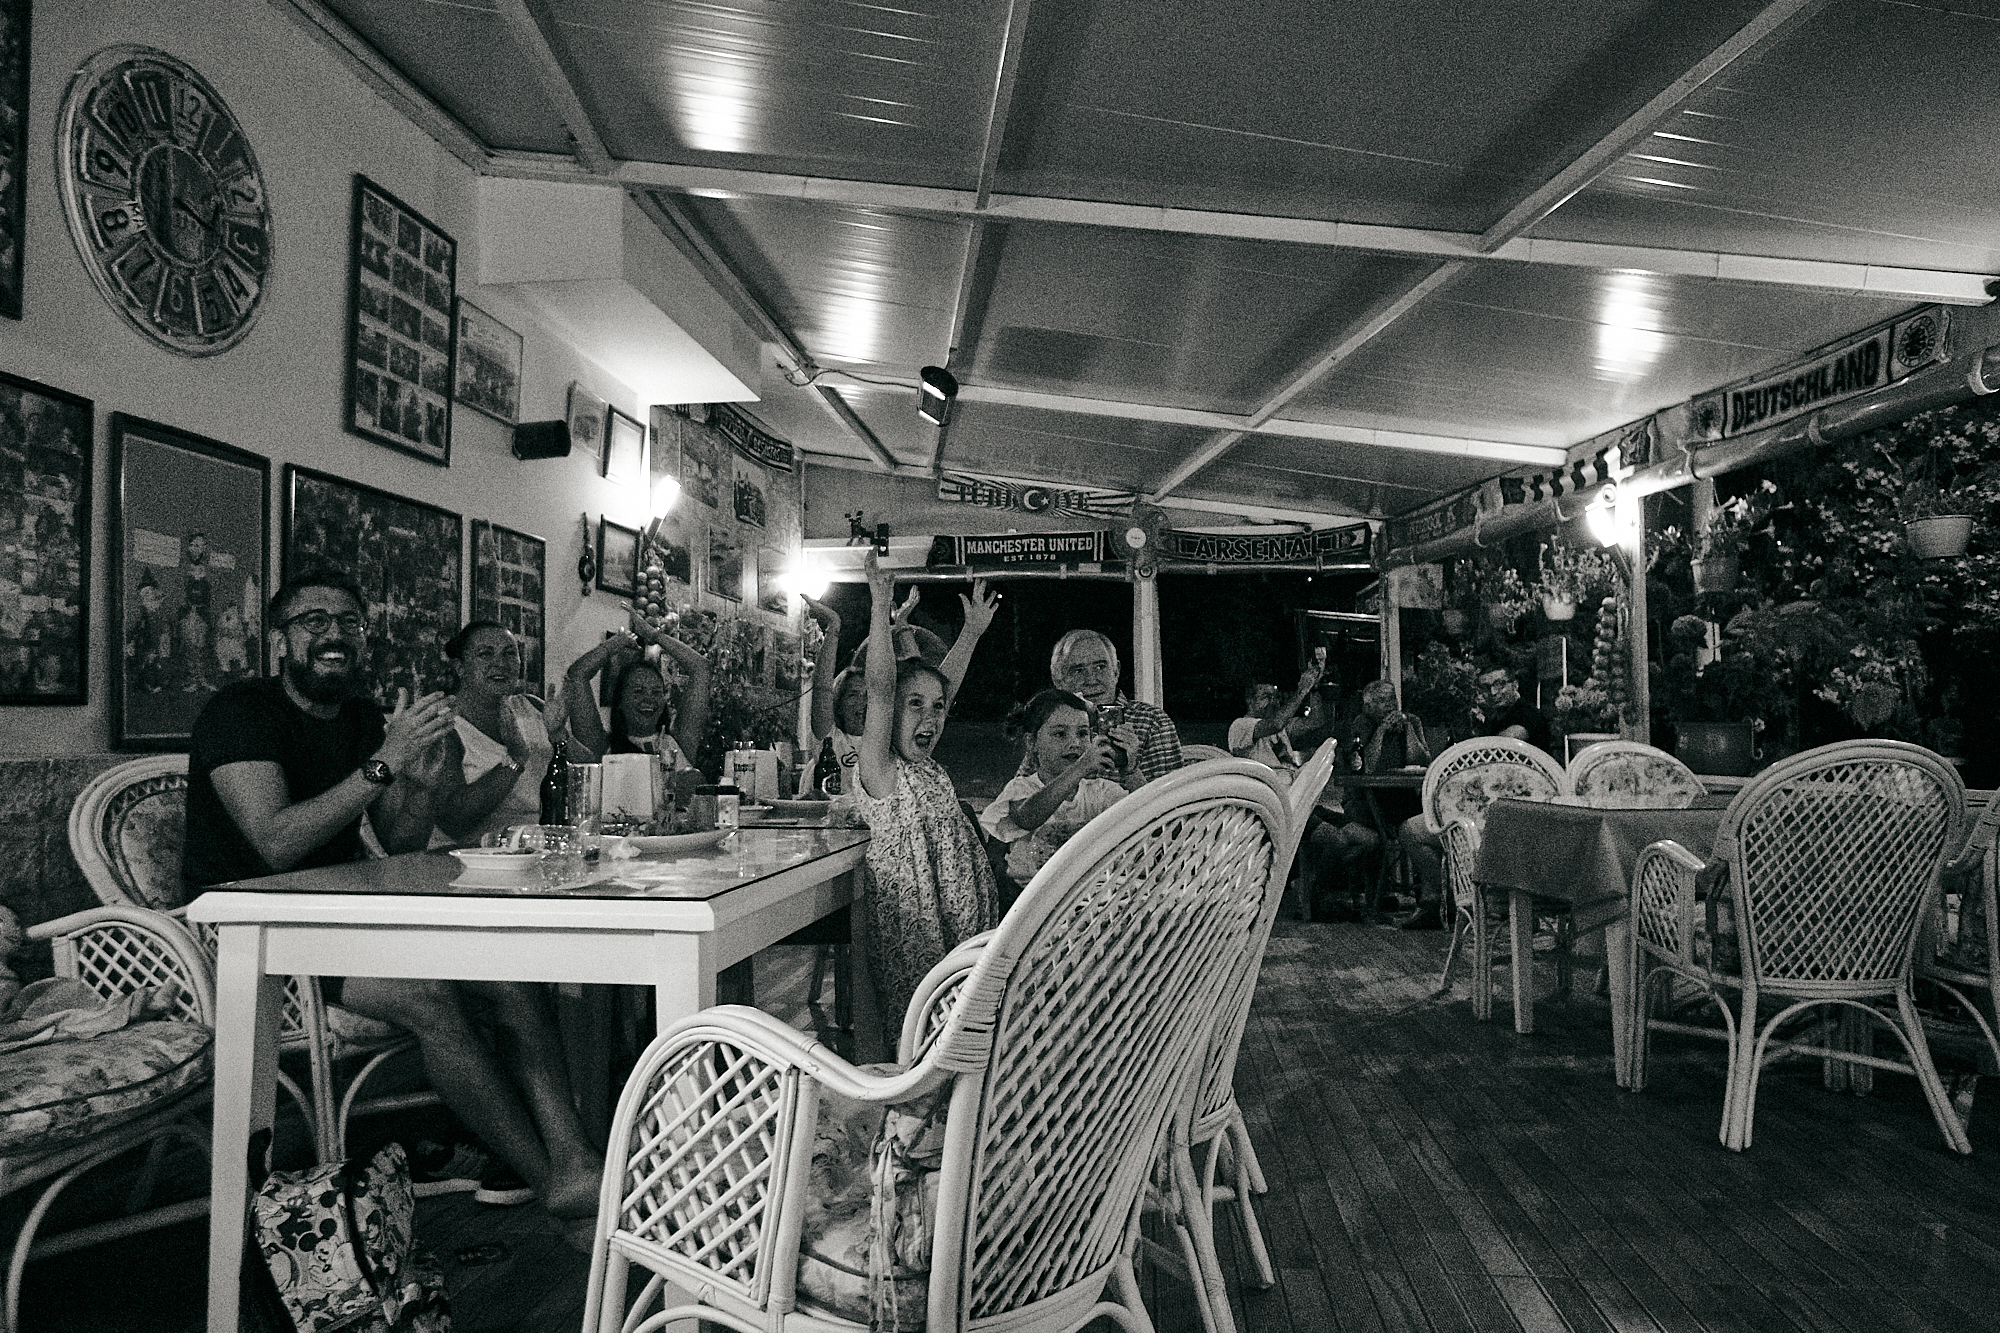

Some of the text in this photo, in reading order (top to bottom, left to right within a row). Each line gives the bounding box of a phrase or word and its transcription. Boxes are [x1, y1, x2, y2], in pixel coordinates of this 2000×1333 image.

[139, 80, 167, 124] 11
[177, 87, 202, 129] 12
[106, 100, 140, 143] 10
[214, 130, 235, 157] 1
[95, 149, 131, 179] 9
[230, 186, 258, 206] 2
[101, 208, 129, 232] 8
[233, 231, 259, 256] 3
[170, 273, 186, 313] 6
[222, 263, 251, 299] 4
[202, 284, 221, 325] 5
[1729, 336, 1882, 434] DEUTSCHLAND
[966, 536, 1093, 555] MANCHESTER UNITED
[1029, 553, 1057, 562] 1878
[1194, 532, 1320, 560] ARSENAL
